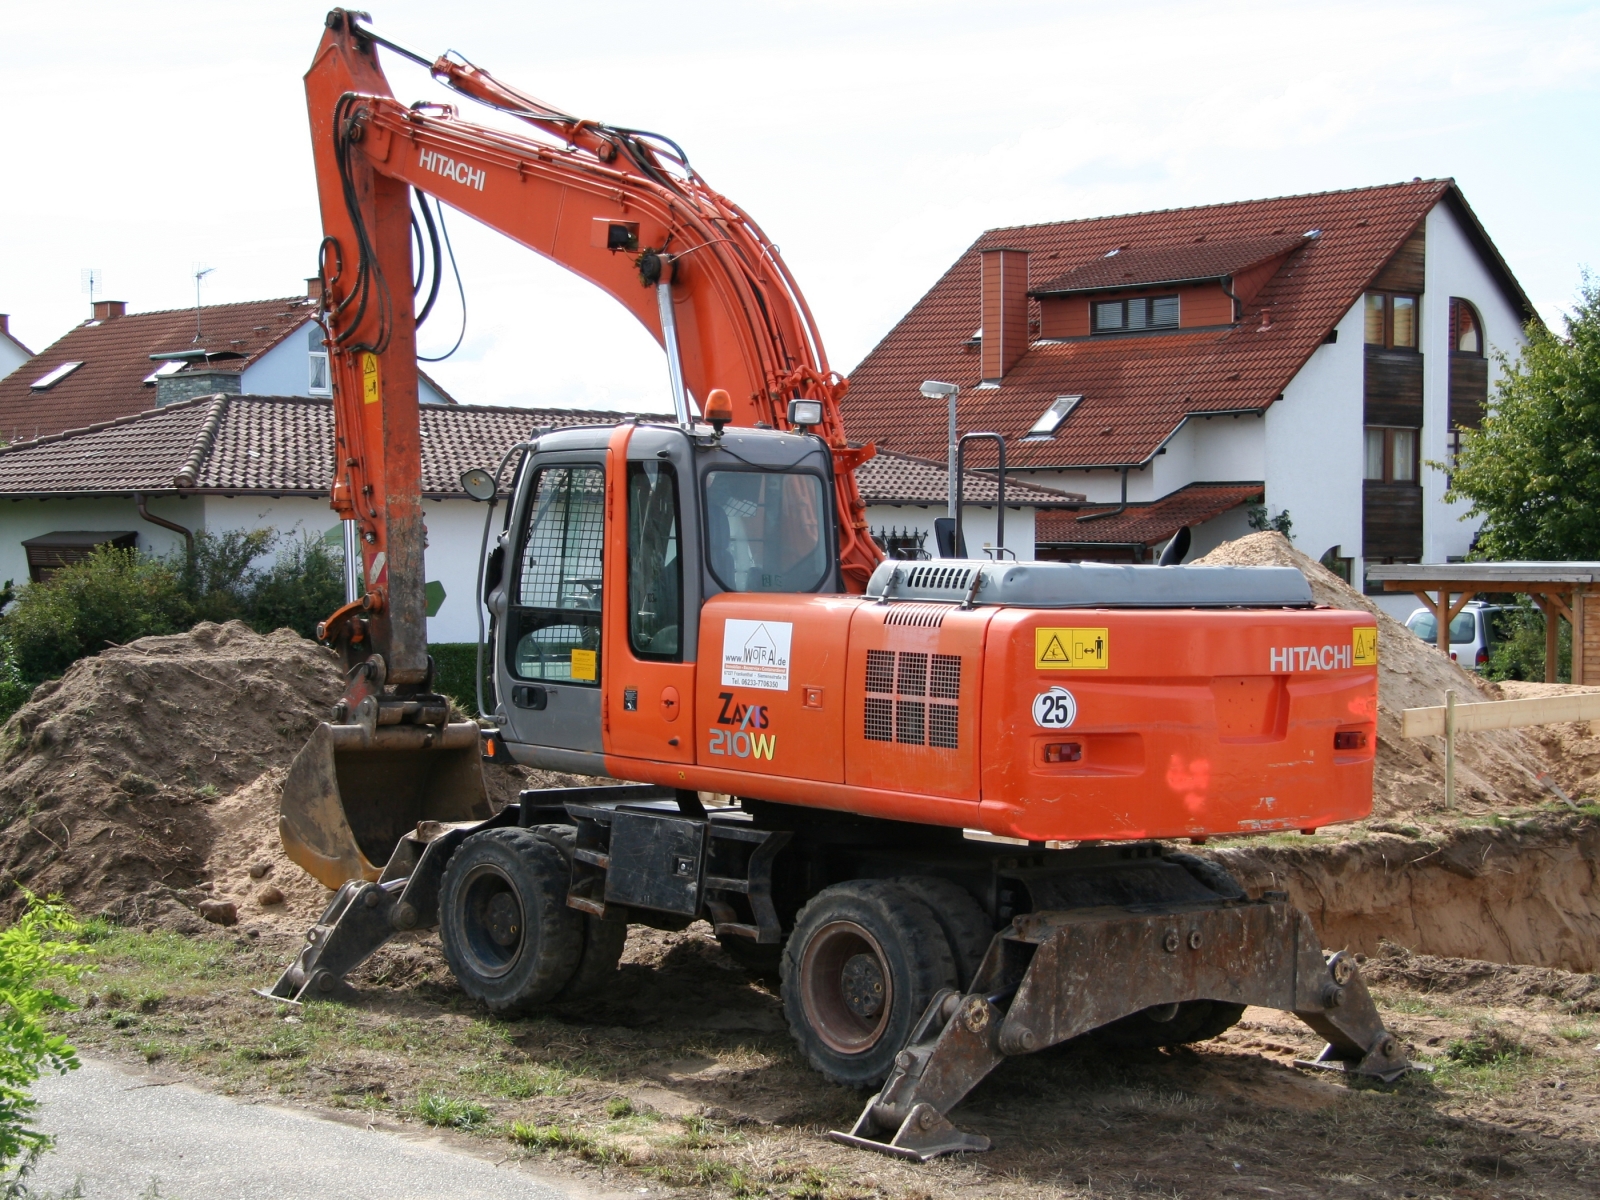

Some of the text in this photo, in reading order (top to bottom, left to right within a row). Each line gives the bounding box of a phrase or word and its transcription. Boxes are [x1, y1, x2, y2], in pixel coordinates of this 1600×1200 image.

[419, 148, 486, 191] HITACHI
[1270, 645, 1351, 672] HITACHI
[732, 677, 740, 685] Tel.
[717, 692, 769, 730] ZAXIS
[1042, 695, 1068, 724] 25
[709, 728, 777, 760] 210W
